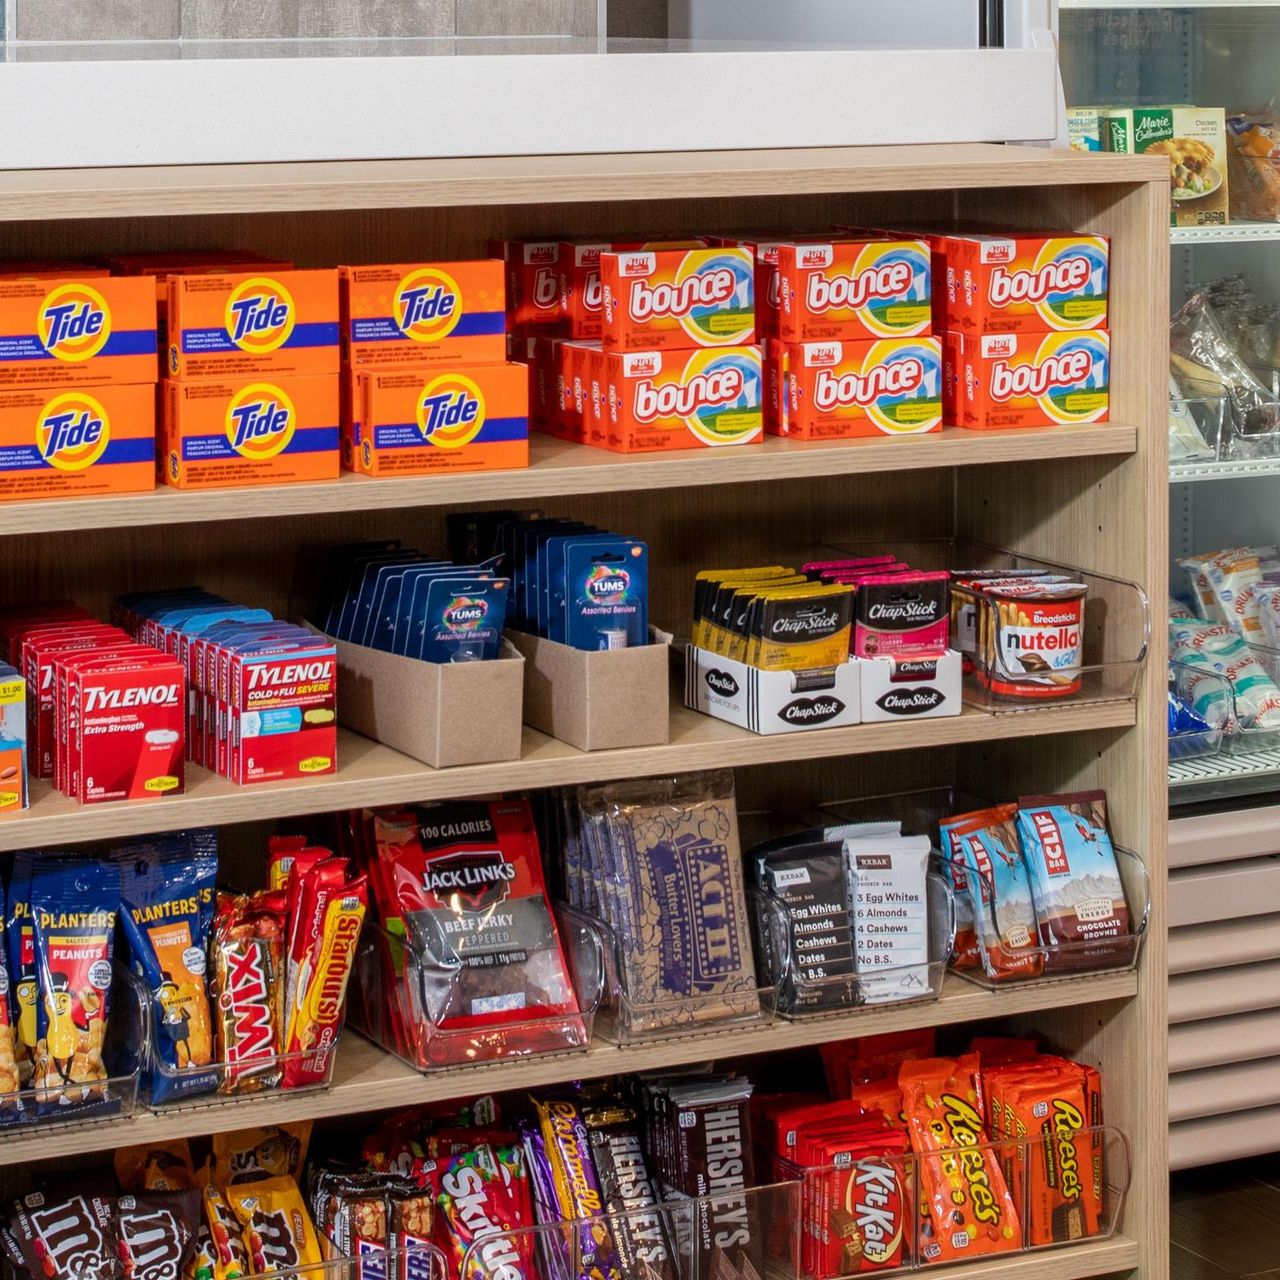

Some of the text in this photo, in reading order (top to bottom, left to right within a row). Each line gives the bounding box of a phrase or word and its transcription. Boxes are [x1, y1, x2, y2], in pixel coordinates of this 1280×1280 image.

[1135, 116, 1170, 132] Marie
[1135, 128, 1174, 143] Callender's
[807, 263, 911, 312] bounce
[989, 258, 1090, 306] bounce
[630, 269, 733, 321] bounce
[399, 284, 456, 332] Tide
[43, 301, 104, 351] Tide
[231, 294, 289, 343] Tide
[816, 360, 921, 410] bounce
[991, 352, 1091, 400] bounce
[635, 368, 742, 422] bounce
[422, 391, 479, 438] Tide
[42, 410, 103, 460] Tide
[231, 401, 289, 450] Tide
[592, 581, 625, 593] TUMS
[450, 608, 482, 620] TUMS
[581, 605, 637, 616] Assorted Berries
[869, 600, 938, 621] ChapStick
[1033, 613, 1076, 624] Breadsticks
[771, 613, 839, 634] ChapStick
[435, 630, 491, 641] Assorted Berries
[1007, 628, 1078, 651] nutella
[247, 661, 332, 690] TYLENOL
[708, 672, 736, 693] ChapStick
[2, 685, 22, 695] $1.00
[296, 682, 330, 694] SEVERE
[83, 684, 179, 713] TYLENOL
[884, 692, 938, 709] ChapStick
[785, 701, 839, 721] ChapStick
[84, 721, 145, 735] Extra Strength
[247, 758, 254, 768] 6
[86, 777, 94, 787] 6
[420, 819, 492, 839] 100 CALORIES
[1034, 814, 1062, 860] CLIF
[860, 858, 888, 866] RXBAR
[1047, 857, 1066, 868] BAR
[422, 863, 516, 892] JACK LINK'S
[779, 872, 806, 882] RXBAR
[664, 873, 679, 917] Butter
[857, 892, 920, 904] 3 Egg Whites
[40, 911, 116, 929] PLANTERS
[132, 902, 199, 925] PLANTERS
[696, 859, 732, 962] ACT II
[790, 902, 842, 919] Egg Whites
[857, 908, 908, 918] 6 Almonds
[1079, 907, 1112, 919] ENERGY
[444, 914, 514, 934] BEEF JERKY
[793, 918, 834, 934] Almonds
[857, 924, 908, 934] 4 Cashews
[1076, 919, 1121, 933] CHOCOLATE
[155, 934, 188, 947] PEANUTS
[670, 917, 685, 963] Lovers
[795, 934, 837, 950] Cashews
[857, 939, 894, 949] 2 Dates
[1083, 929, 1118, 940] BROWNIE
[52, 948, 103, 960] PEANUTS
[468, 955, 485, 966] 100%
[798, 952, 825, 966] Dates
[857, 955, 893, 965] No B.S.
[317, 915, 363, 1025] Starburst
[941, 1092, 1004, 1225] Reese's
[1051, 1098, 1084, 1200] Reese's
[554, 1101, 602, 1218] Caramello
[703, 1109, 750, 1249] HERSHEY'S
[609, 1135, 668, 1263] HERSHEY'S
[699, 1197, 711, 1250] chocolate
